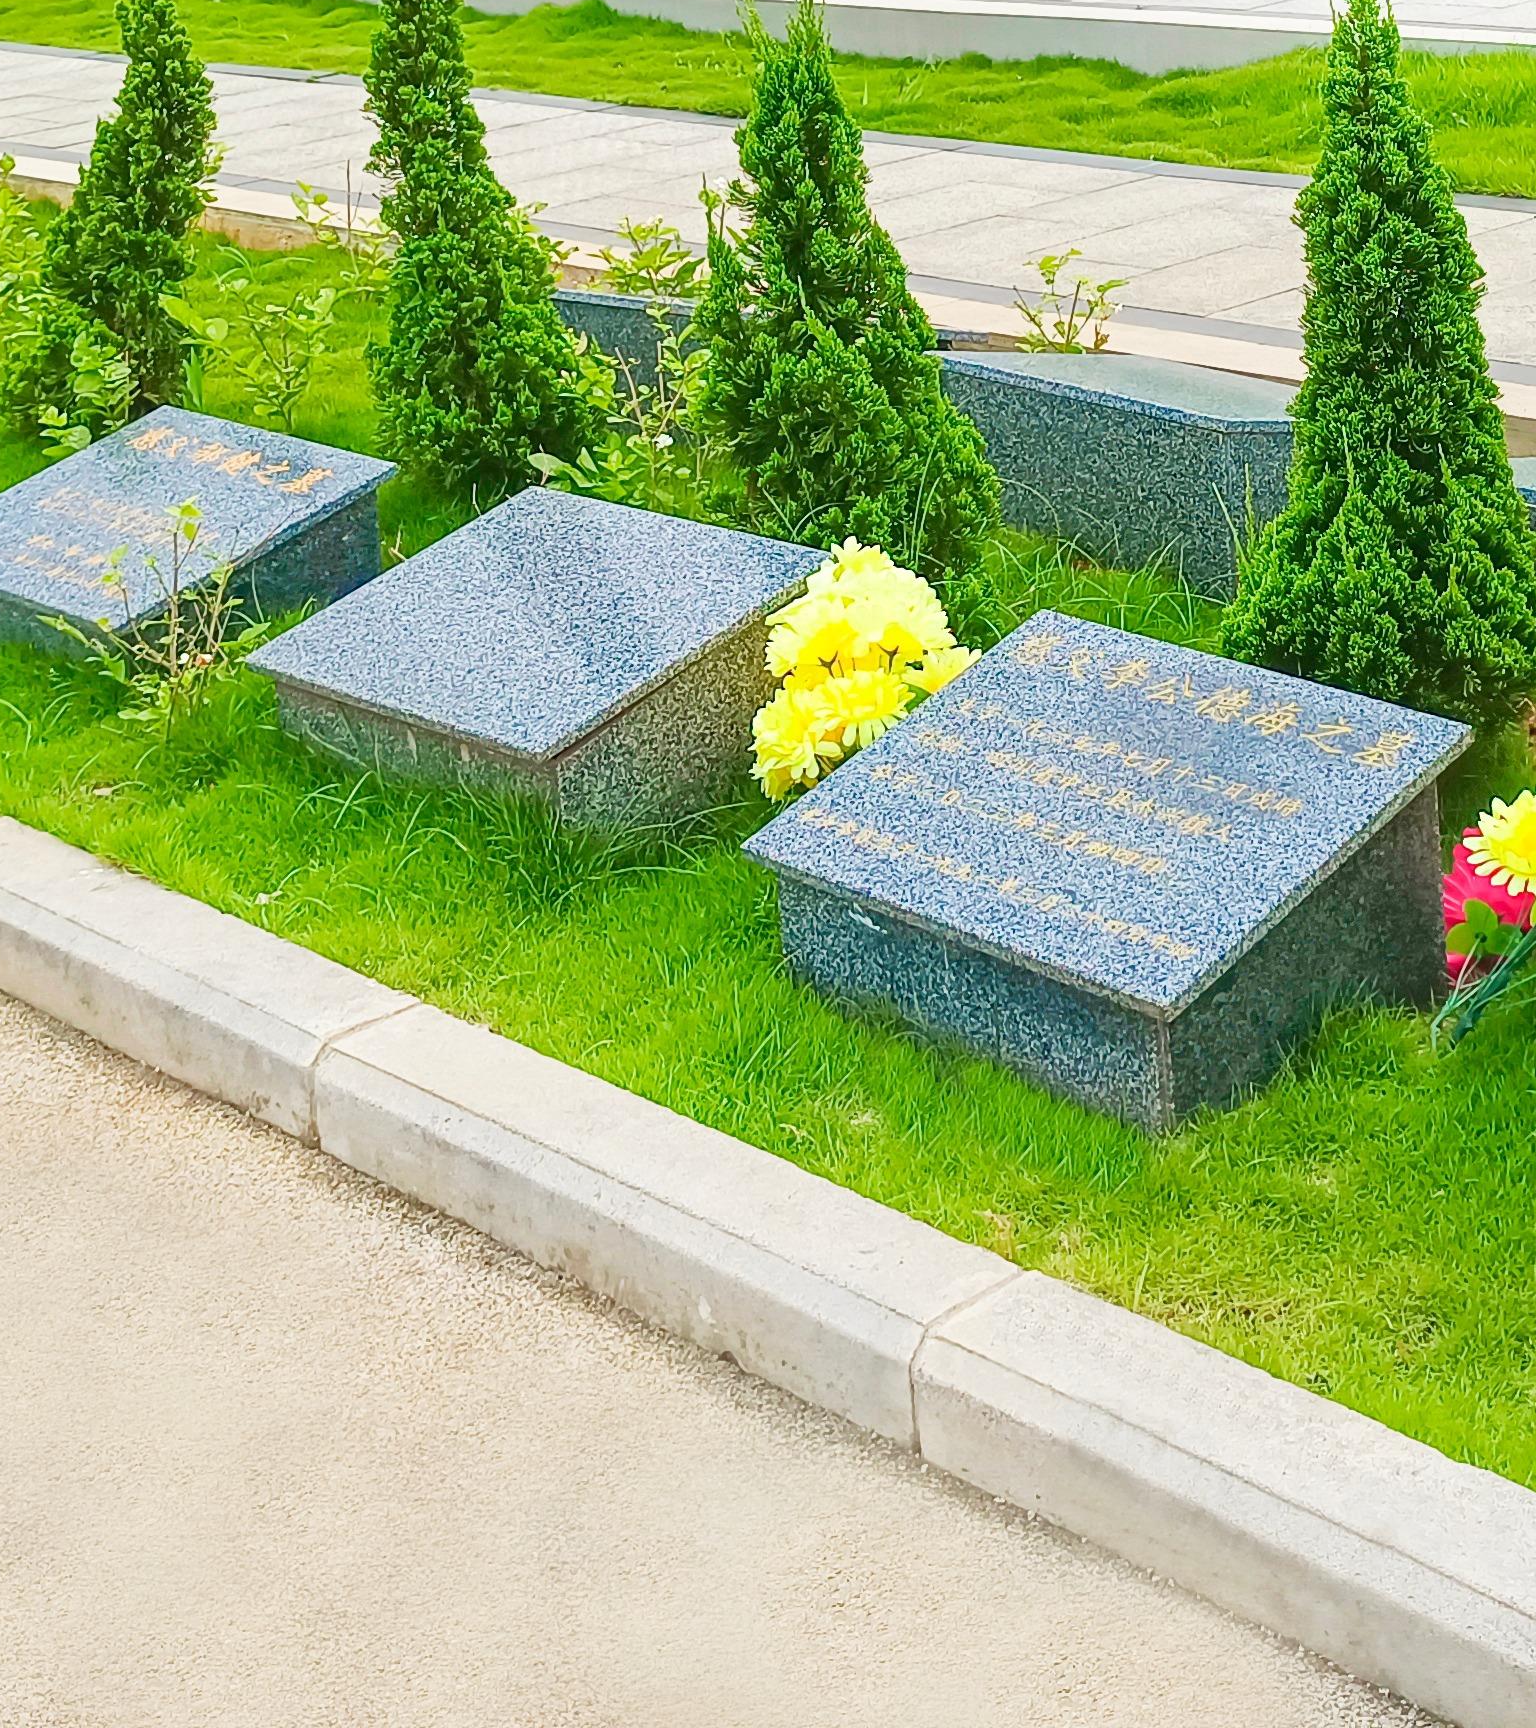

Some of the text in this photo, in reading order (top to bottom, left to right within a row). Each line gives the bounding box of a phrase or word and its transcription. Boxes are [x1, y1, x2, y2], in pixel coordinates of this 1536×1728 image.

[1010, 631, 1418, 770] 慈父李公德海之墓
